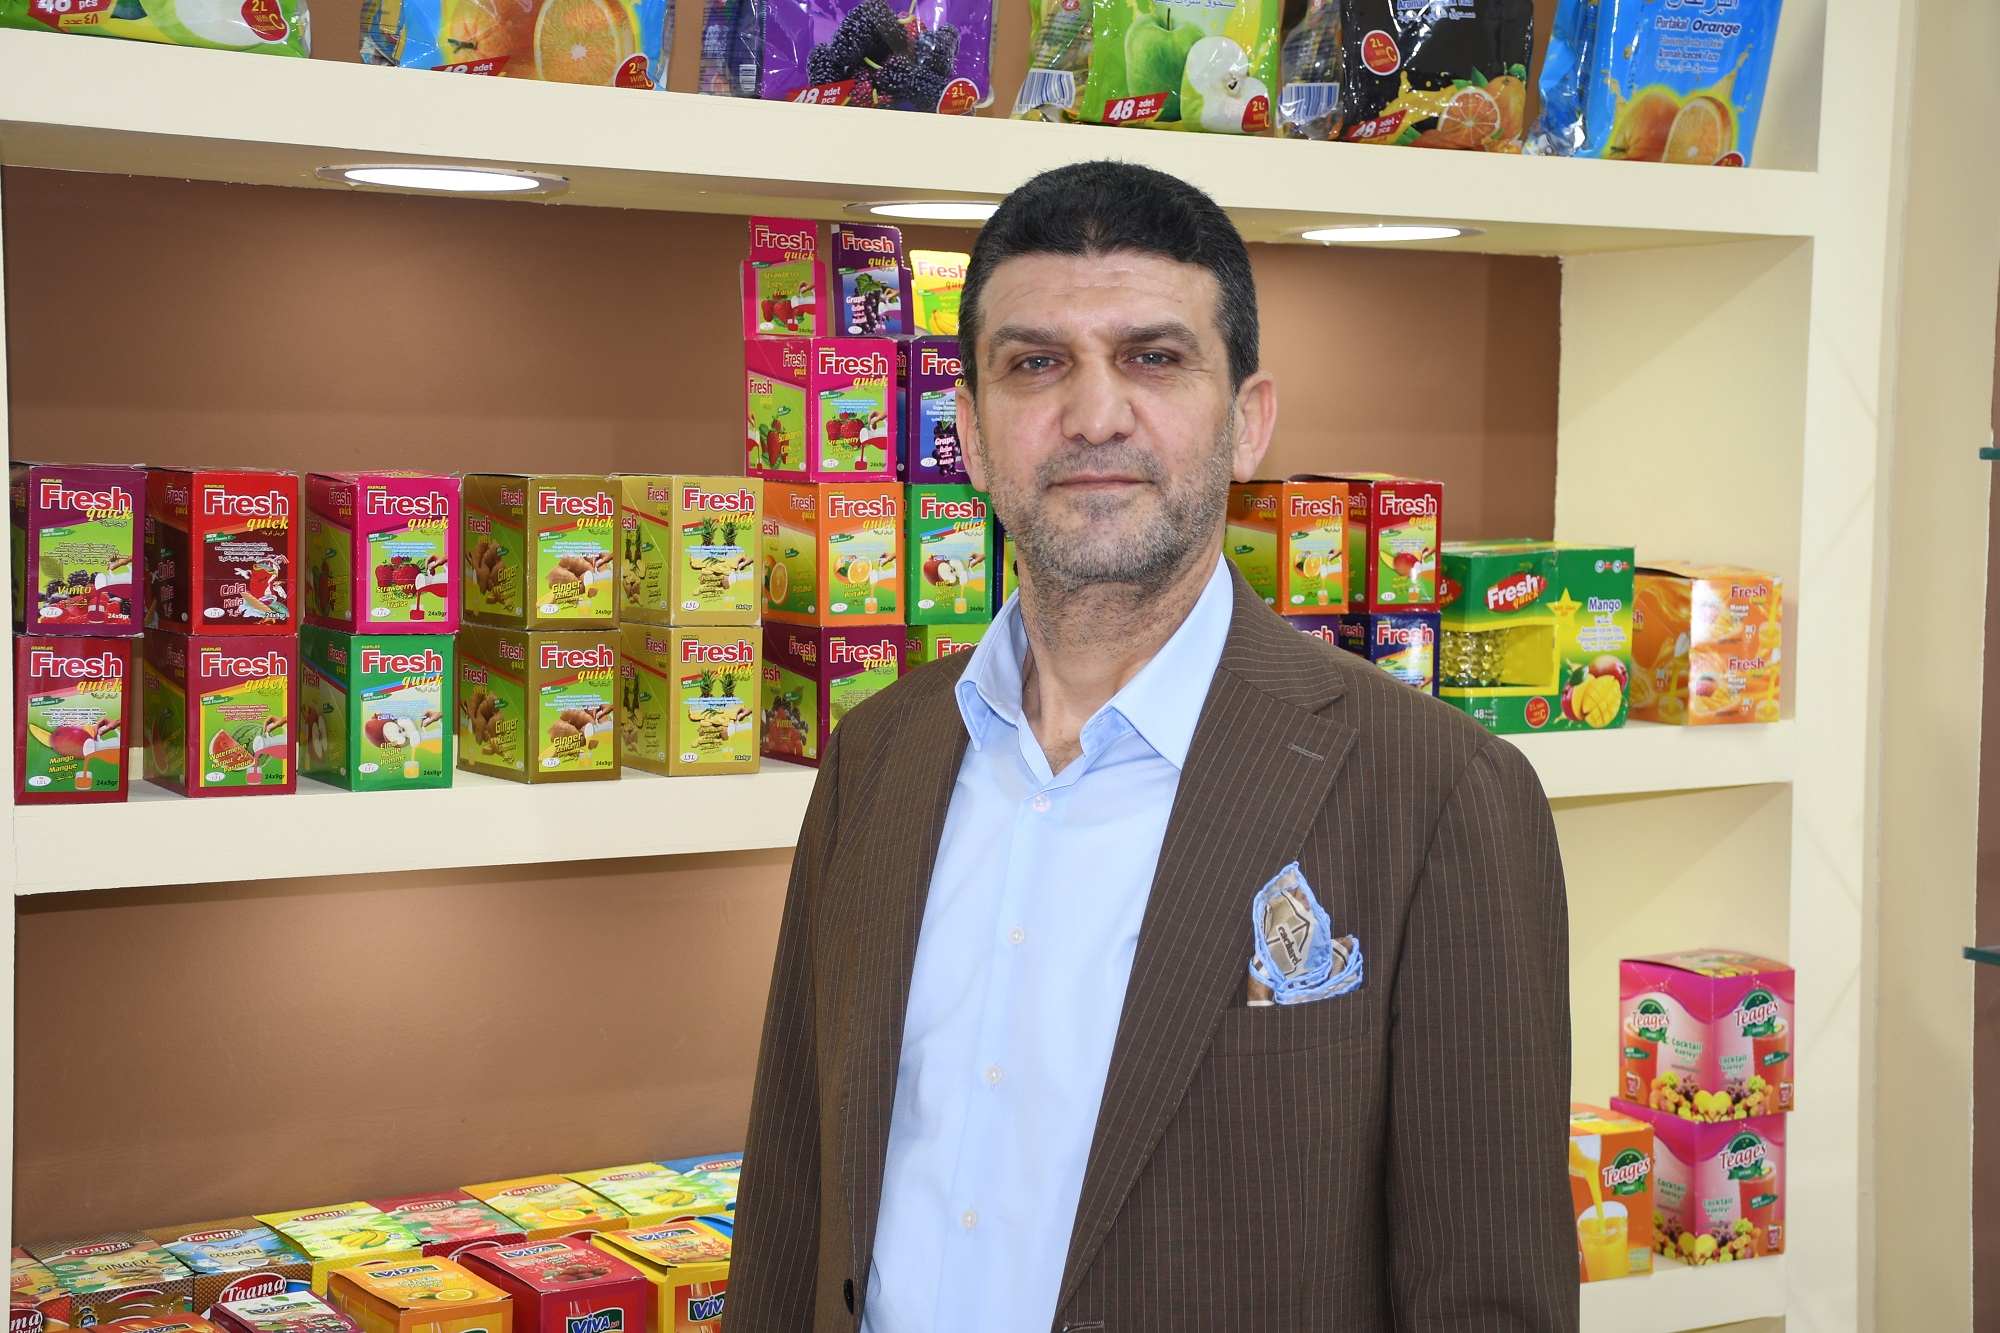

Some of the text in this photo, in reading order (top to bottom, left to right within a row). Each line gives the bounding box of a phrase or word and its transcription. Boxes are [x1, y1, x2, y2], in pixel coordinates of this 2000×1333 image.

[1655, 16, 1742, 38] Portakal Orange
[1370, 37, 1383, 47] 2L
[1386, 46, 1397, 62] C
[792, 86, 841, 104] 48 adet
[1109, 99, 1155, 120] 48 adet
[1136, 108, 1151, 116] pcs
[1351, 118, 1395, 138] 48 adet
[755, 227, 814, 251] Fresh
[842, 232, 895, 253] Fresh
[784, 250, 815, 262] quick
[868, 256, 898, 269] quick
[763, 271, 800, 279] Strawberry
[917, 259, 967, 280] Fresh
[774, 288, 794, 296] Fraise
[846, 295, 866, 304] Grape
[782, 350, 807, 368] Fresh
[818, 351, 888, 375] Fresh
[793, 367, 807, 377] quick
[749, 378, 772, 396] Fresh
[853, 374, 888, 389] quick
[827, 437, 860, 446] Strawberry
[934, 436, 954, 446] Grape
[40, 483, 132, 511] Fresh
[165, 485, 189, 505] Fresh
[328, 487, 351, 506] Fresh
[500, 488, 524, 506] Fresh
[647, 484, 669, 502] Fresh
[682, 487, 755, 511] Fresh
[1243, 493, 1277, 510] Fresh
[204, 488, 289, 516] Fresh
[367, 490, 449, 515] Fresh
[538, 491, 614, 515] Fresh
[789, 493, 816, 511] Fresh
[828, 495, 896, 519] Fresh
[920, 497, 986, 520] Fresh
[1290, 496, 1344, 517] Fresh
[1380, 493, 1437, 516] Fresh
[86, 505, 132, 522] quick
[719, 511, 755, 525] quick
[1409, 515, 1437, 527] quick
[246, 515, 289, 531] quick
[407, 515, 449, 531] quick
[467, 515, 491, 534] Fresh
[576, 515, 614, 530] quick
[763, 519, 780, 538] esh
[863, 518, 896, 532] quick
[953, 518, 986, 532] quick
[1315, 518, 1343, 529] quick
[497, 564, 518, 582] Ginger
[220, 583, 246, 597] Cola
[376, 583, 414, 593] Strawberry
[552, 580, 582, 593] Ginger
[844, 588, 871, 599] Portakal
[845, 581, 868, 590] Orange
[1487, 575, 1539, 610] Fresh
[1730, 584, 1767, 600] Fresh
[224, 598, 244, 609] Kola
[1513, 592, 1539, 608] quick
[1588, 597, 1621, 615] Mango
[265, 612, 286, 620] 24x9gr
[1377, 624, 1434, 645] Fresh
[327, 643, 347, 664] Fresh
[500, 640, 524, 660] Fresh
[645, 636, 667, 655] Fresh
[681, 639, 754, 663] Fresh
[788, 637, 817, 656] Fresh
[830, 639, 898, 664] Fresh
[30, 651, 123, 678] Fresh
[166, 646, 185, 666] Fresh
[201, 652, 288, 677] Fresh
[361, 648, 443, 674] Fresh
[540, 644, 614, 669] Fresh
[863, 656, 897, 671] quick
[1729, 657, 1765, 672] Fresh
[462, 664, 488, 685] Fresh
[577, 667, 614, 683] quick
[717, 662, 754, 677] quick
[76, 677, 123, 695] quick
[245, 677, 288, 693] quick
[402, 673, 443, 690] quick
[1473, 709, 1485, 719] 48
[495, 718, 518, 734] Ginger
[380, 741, 397, 750] Elma
[553, 733, 583, 748] Ginger
[49, 755, 74, 764] Mango
[209, 743, 247, 761] Watermelon
[380, 754, 406, 766] Pomme
[381, 748, 401, 758] Apple
[48, 763, 78, 774] Mangue
[211, 757, 234, 769] Karpuz
[1278, 927, 1302, 965] cacharel
[1632, 1012, 1670, 1030] Teages
[1734, 1000, 1779, 1027] Teages
[1672, 1037, 1702, 1052] Cocktail
[1719, 1054, 1746, 1065] Cocktail
[1719, 1141, 1767, 1170] Teages
[1603, 1156, 1651, 1187] Teages
[1657, 1178, 1686, 1194] Cocktail
[1703, 1197, 1733, 1208] Cocktail
[185, 1228, 243, 1241] Taama
[70, 1242, 131, 1255] Taama
[209, 1248, 262, 1258] COCONUT
[97, 1259, 151, 1272] GINGER
[225, 1278, 285, 1302] Taama
